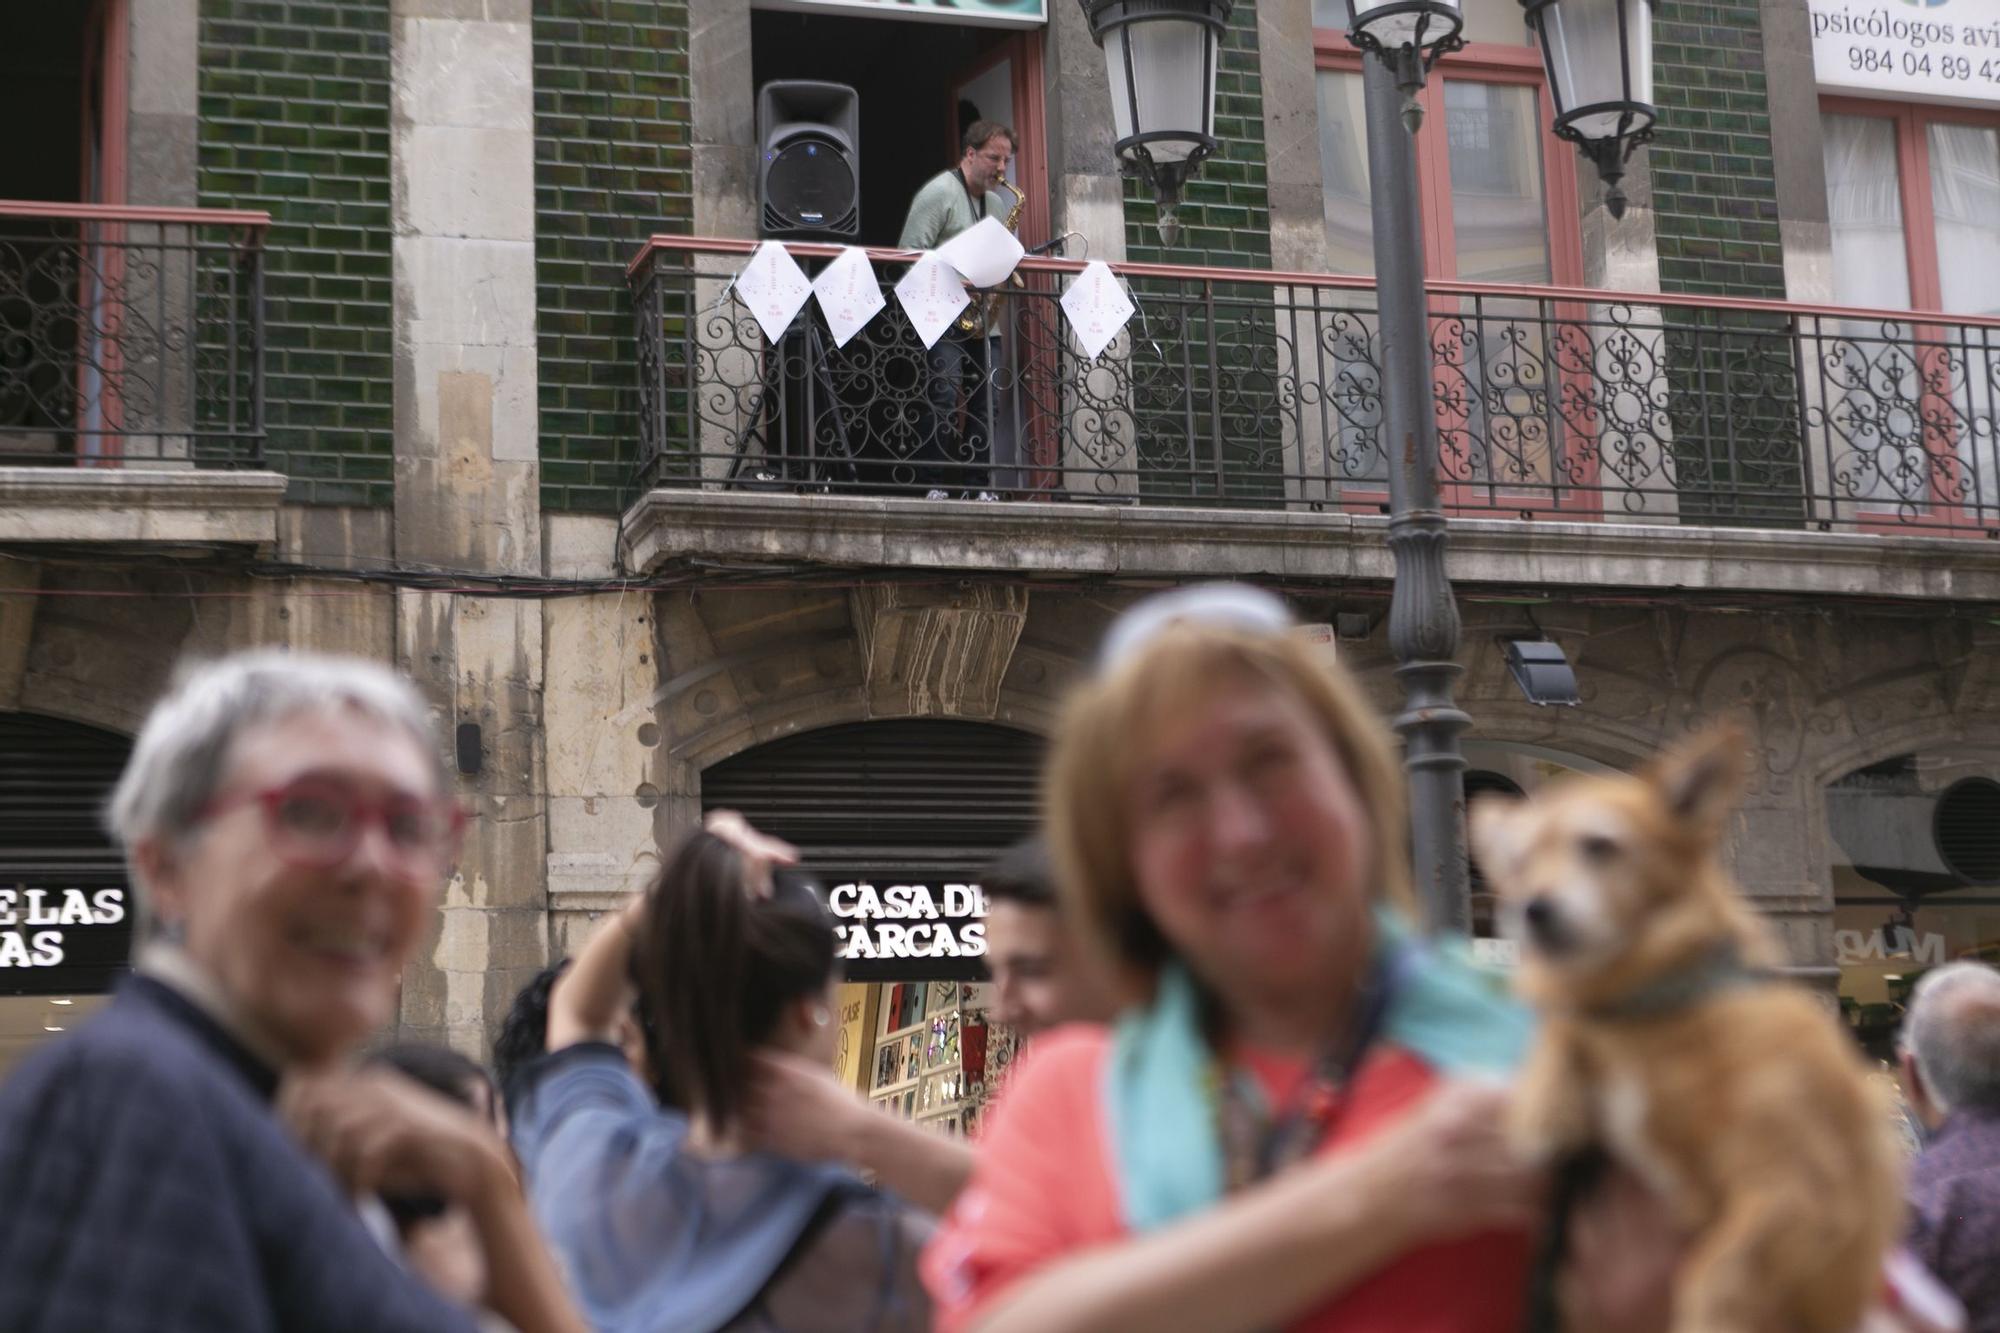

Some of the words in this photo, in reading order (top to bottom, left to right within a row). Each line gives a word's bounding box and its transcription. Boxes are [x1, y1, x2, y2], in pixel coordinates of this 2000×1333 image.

[1812, 6, 1954, 48] psicólogos
[1849, 46, 1893, 73] 984
[1903, 51, 1931, 77] 04
[1942, 55, 1970, 81] 89
[23, 888, 125, 925] LAS
[829, 884, 939, 919] CASA
